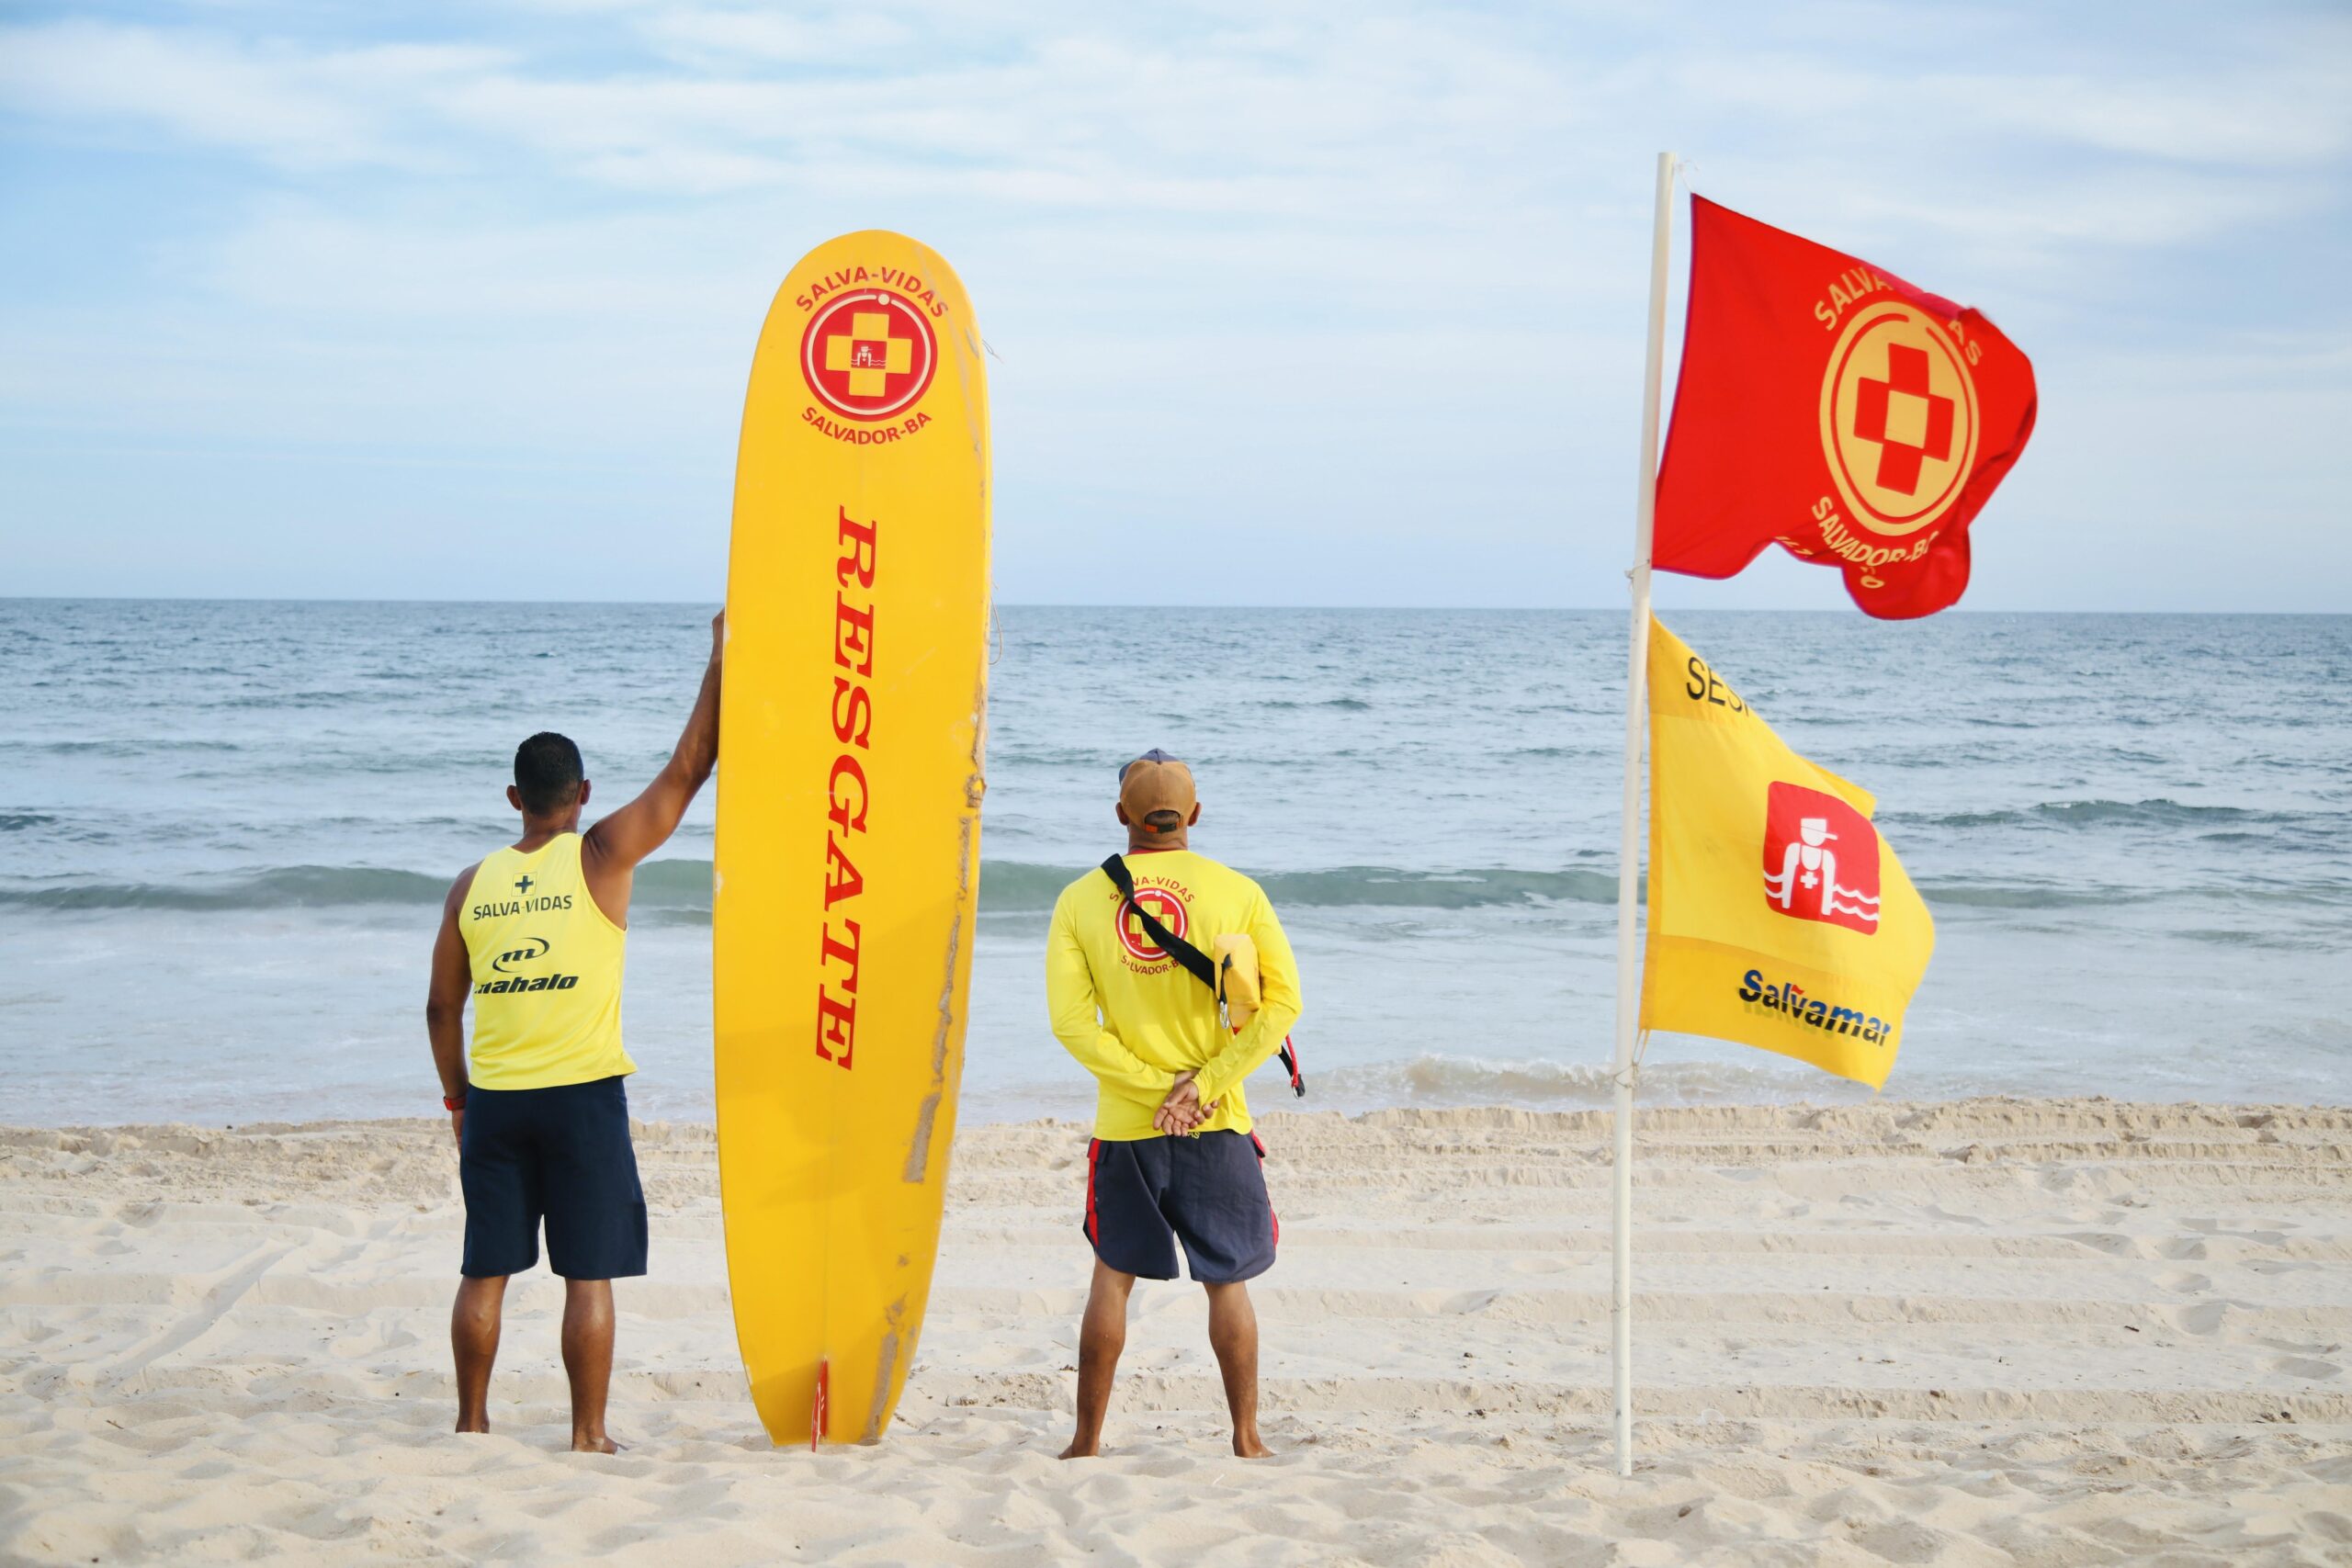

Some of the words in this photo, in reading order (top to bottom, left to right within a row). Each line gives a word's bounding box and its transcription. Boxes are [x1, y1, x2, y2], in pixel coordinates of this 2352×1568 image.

[796, 266, 949, 318] SALVA-VIDAS
[801, 406, 933, 446] SALVADOR-BA
[815, 504, 877, 1072] RESGATE
